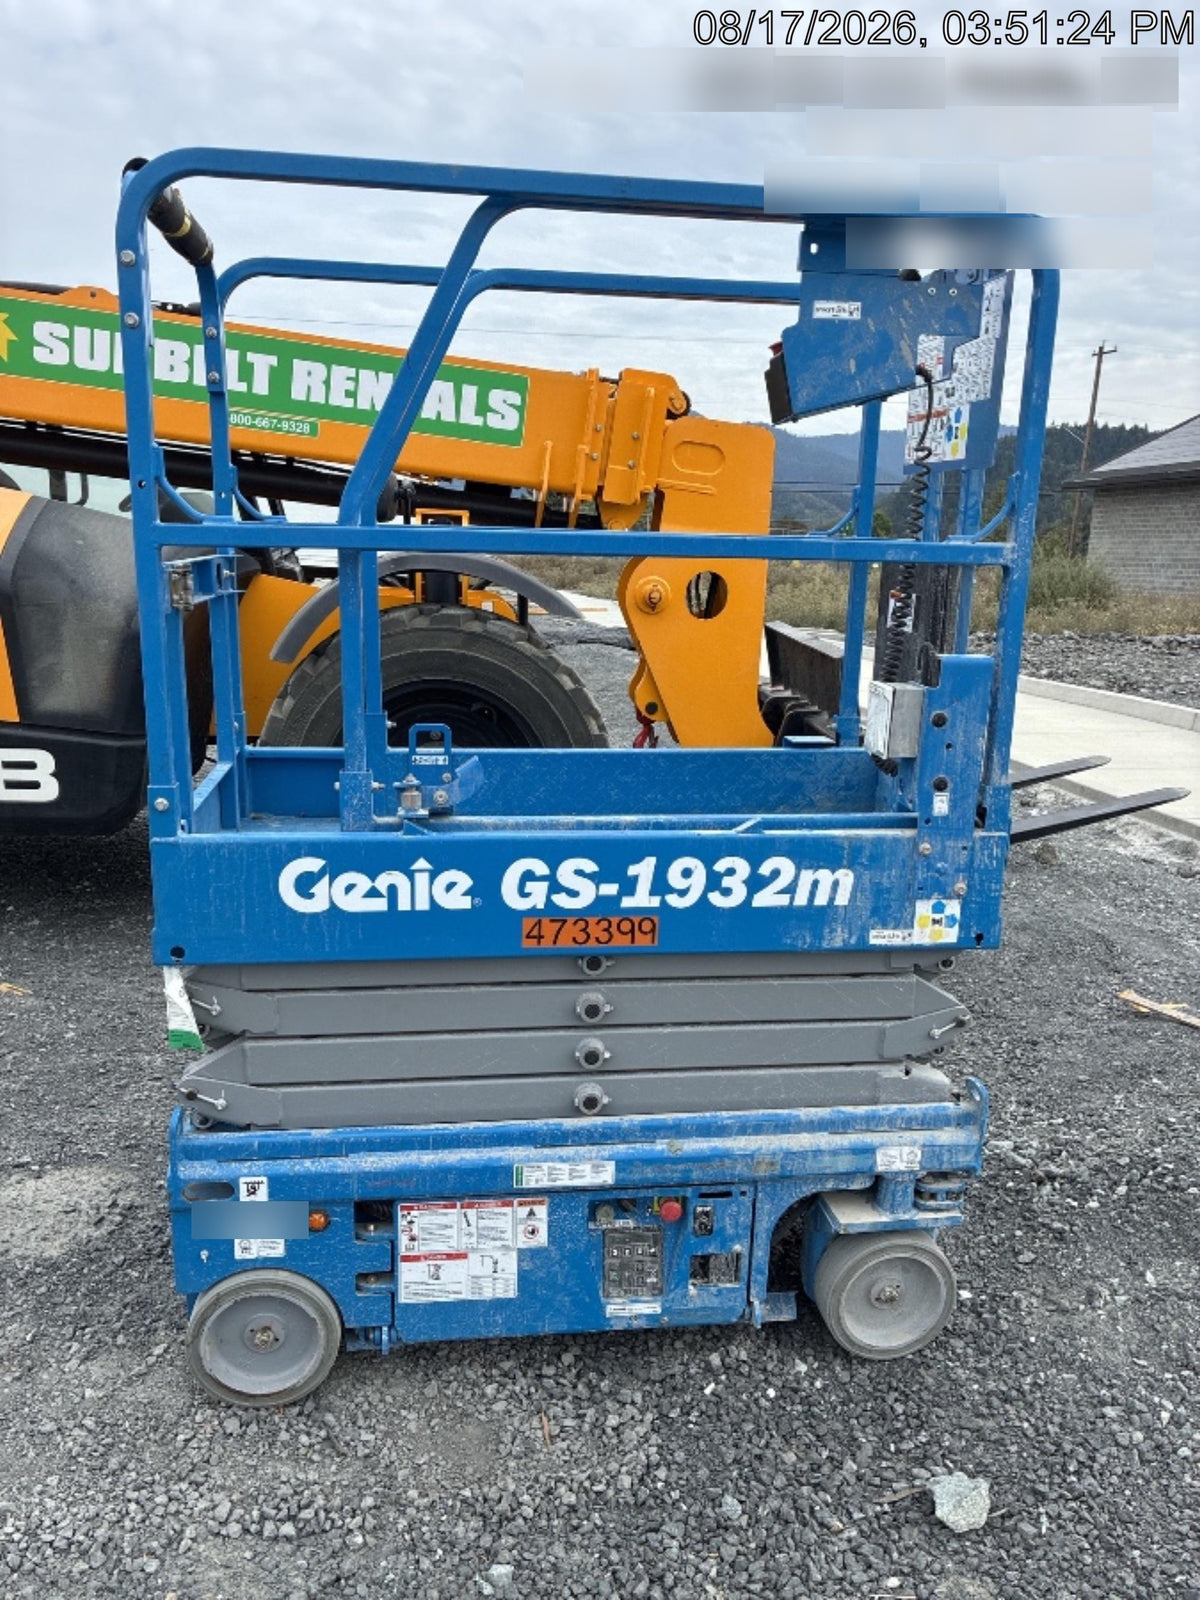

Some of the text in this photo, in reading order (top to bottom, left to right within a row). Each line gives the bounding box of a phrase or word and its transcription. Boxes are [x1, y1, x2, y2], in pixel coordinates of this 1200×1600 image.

[33, 321, 521, 431] SUBLT RENALS
[278, 856, 855, 914] Genie GS-1932m
[525, 918, 657, 946] 473399
